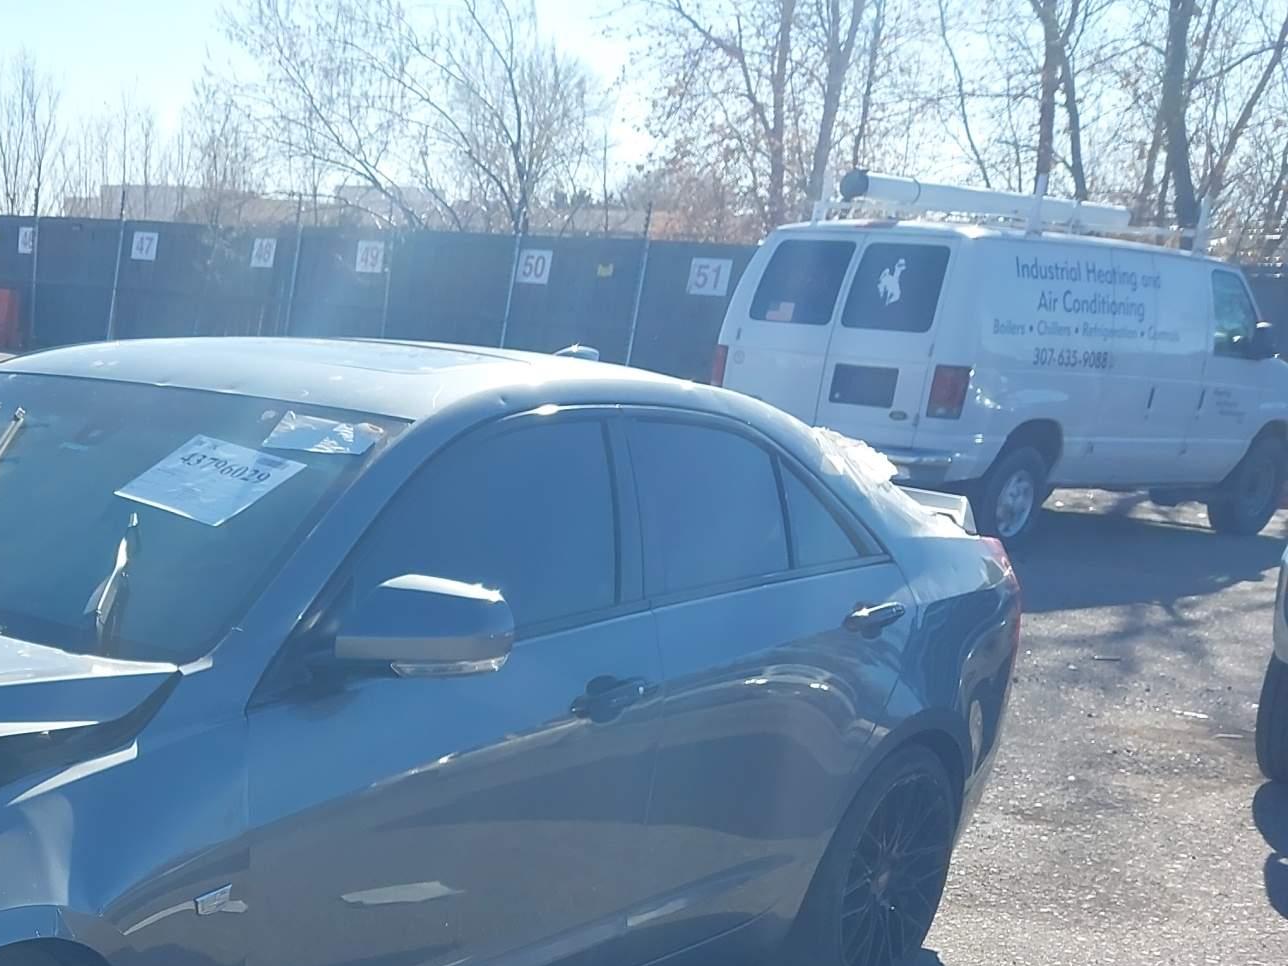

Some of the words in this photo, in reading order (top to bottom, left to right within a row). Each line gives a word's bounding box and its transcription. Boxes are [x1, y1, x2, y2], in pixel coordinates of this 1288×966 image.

[136, 236, 154, 255] 47
[360, 244, 379, 268] 49
[521, 254, 546, 279] 50
[694, 263, 722, 290] 51
[1015, 255, 1082, 282] Industrial
[1085, 260, 1138, 291] Heating
[1141, 271, 1161, 289] and
[1036, 290, 1059, 313] Air
[1062, 289, 1146, 323] Conditioning
[992, 318, 1026, 336] Boilers
[1037, 319, 1072, 336] Chillers
[1032, 346, 1108, 369] 307-635-9088
[179, 451, 272, 484] 43796029
